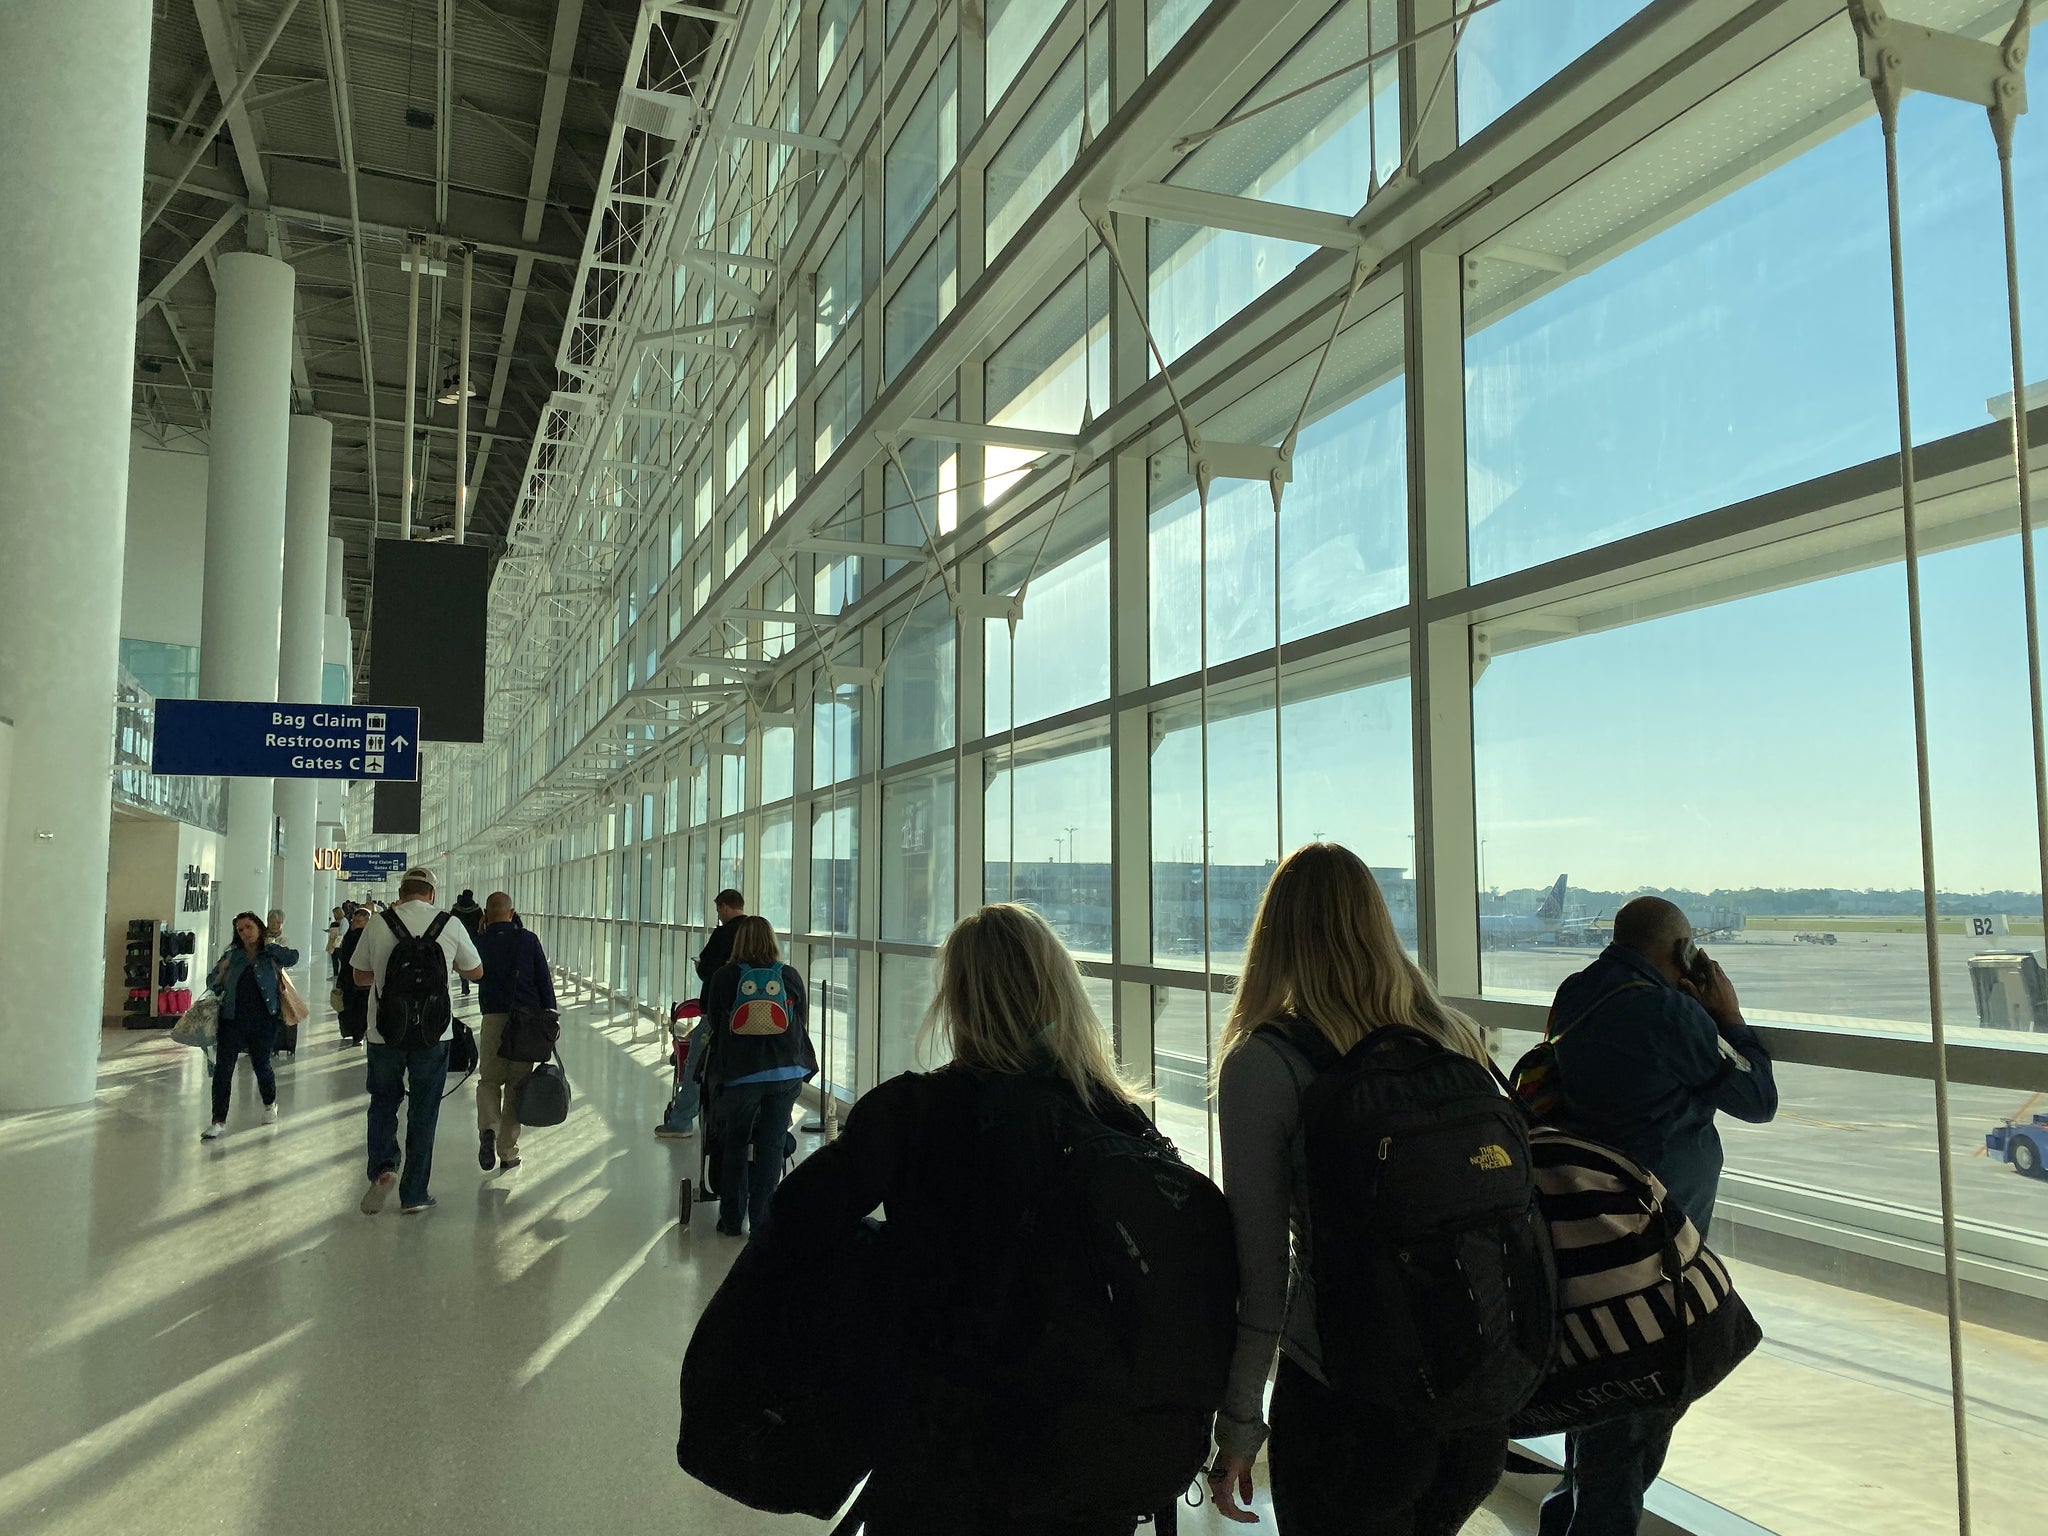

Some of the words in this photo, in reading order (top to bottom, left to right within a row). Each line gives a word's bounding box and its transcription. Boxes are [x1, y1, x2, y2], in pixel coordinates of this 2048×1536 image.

[272, 712, 305, 729] Bag
[313, 713, 362, 728] Claim
[265, 733, 361, 749] Restrooms
[291, 756, 343, 770] Gates
[349, 756, 361, 770] C
[1973, 917, 1993, 935] B2
[1479, 1146, 1494, 1155] THE
[1470, 1153, 1497, 1165] NORTH
[1480, 1161, 1501, 1170] FACE
[1577, 1371, 1666, 1407] SECRET
